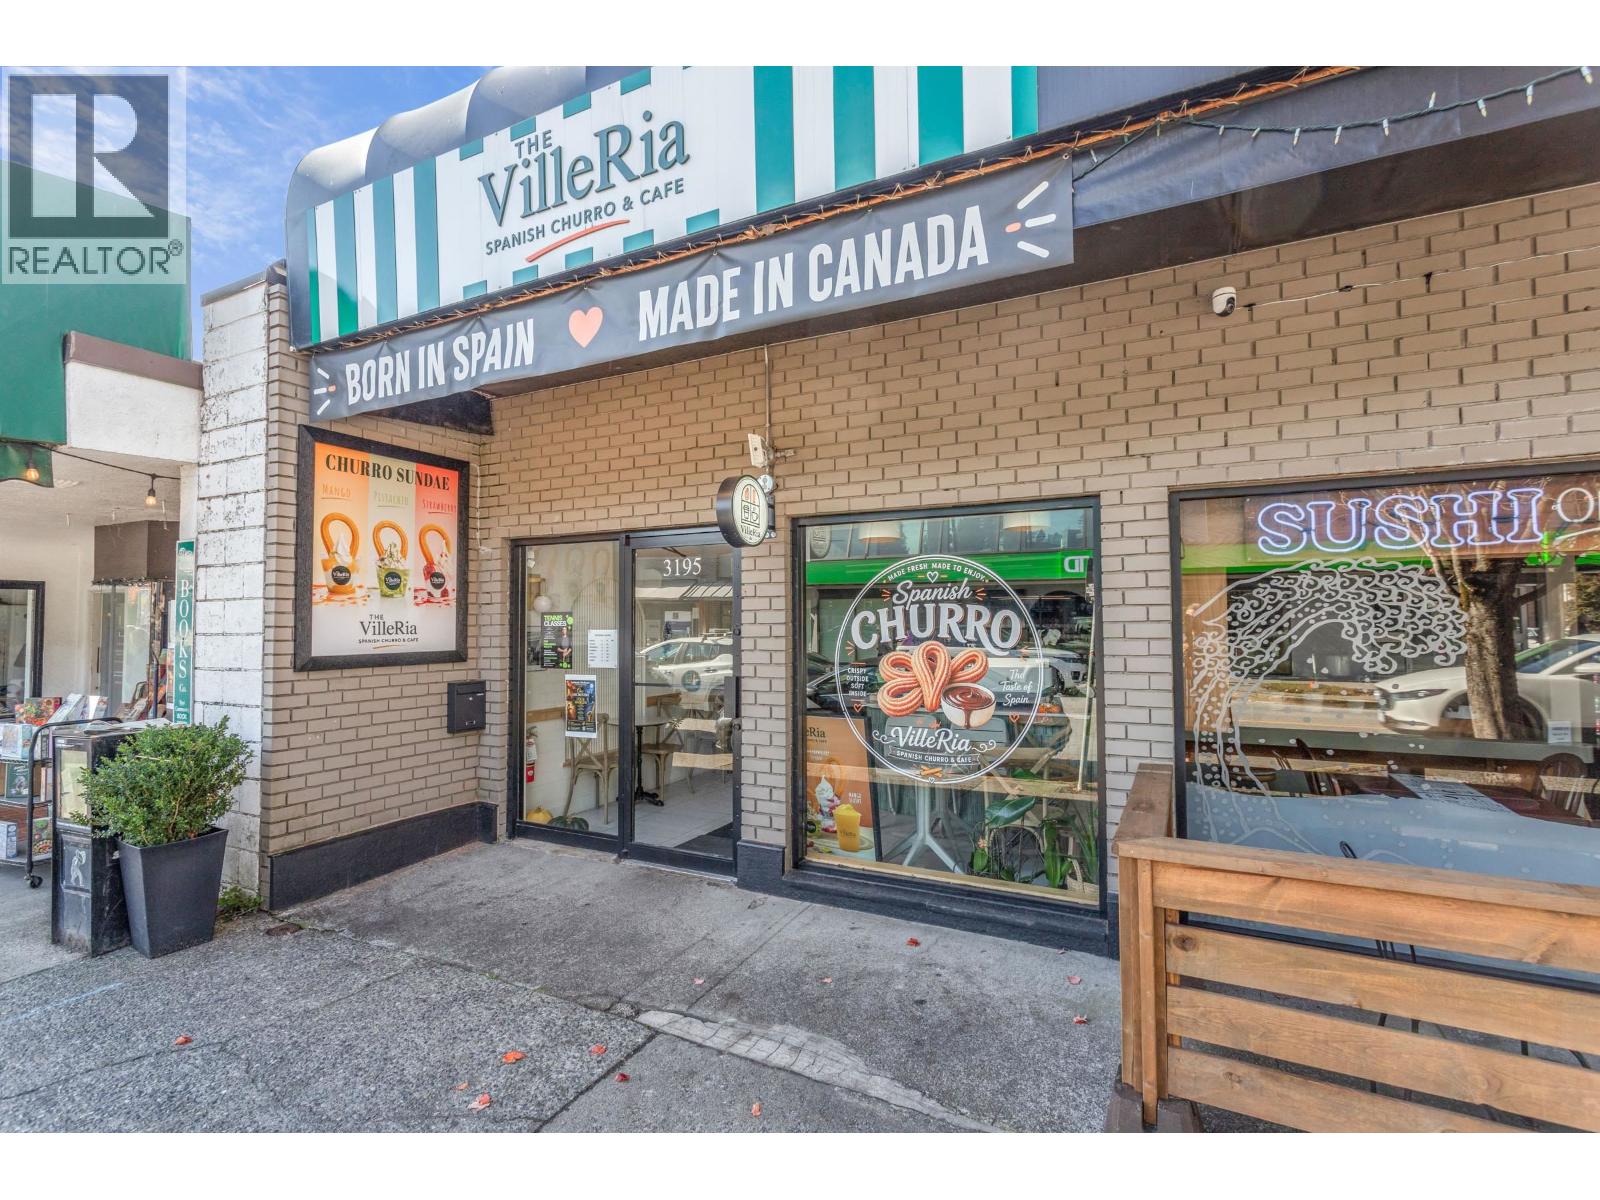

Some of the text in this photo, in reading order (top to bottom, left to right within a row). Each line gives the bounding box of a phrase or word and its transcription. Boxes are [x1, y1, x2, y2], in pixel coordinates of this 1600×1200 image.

[515, 130, 553, 159] THE
[477, 110, 690, 227] VilleRia
[485, 178, 685, 255] SPANISH CHURRO & CAFE
[345, 205, 989, 406] BORN IN SPAIN MADE IN CANADA
[325, 453, 450, 491] CHURRO SUNDAE
[1257, 487, 1544, 555] SUSHI
[663, 557, 702, 577] 3195
[887, 570, 906, 582] MADE
[907, 563, 928, 573] FRESH
[931, 562, 951, 570] MADE
[952, 564, 962, 572] TO
[892, 577, 974, 611] Spanish
[178, 579, 190, 679] BOOKS
[359, 620, 418, 636] VilleRia
[851, 602, 1022, 656] CHURRO
[850, 682, 865, 690] SOFT
[1000, 680, 1033, 694] Taste of
[1009, 668, 1025, 680] The
[1002, 693, 1029, 707] Spain
[890, 725, 973, 754] VilleRia
[896, 750, 923, 761] SPANISH
[924, 755, 949, 763] CHURRO
[956, 755, 972, 763] CAFE
